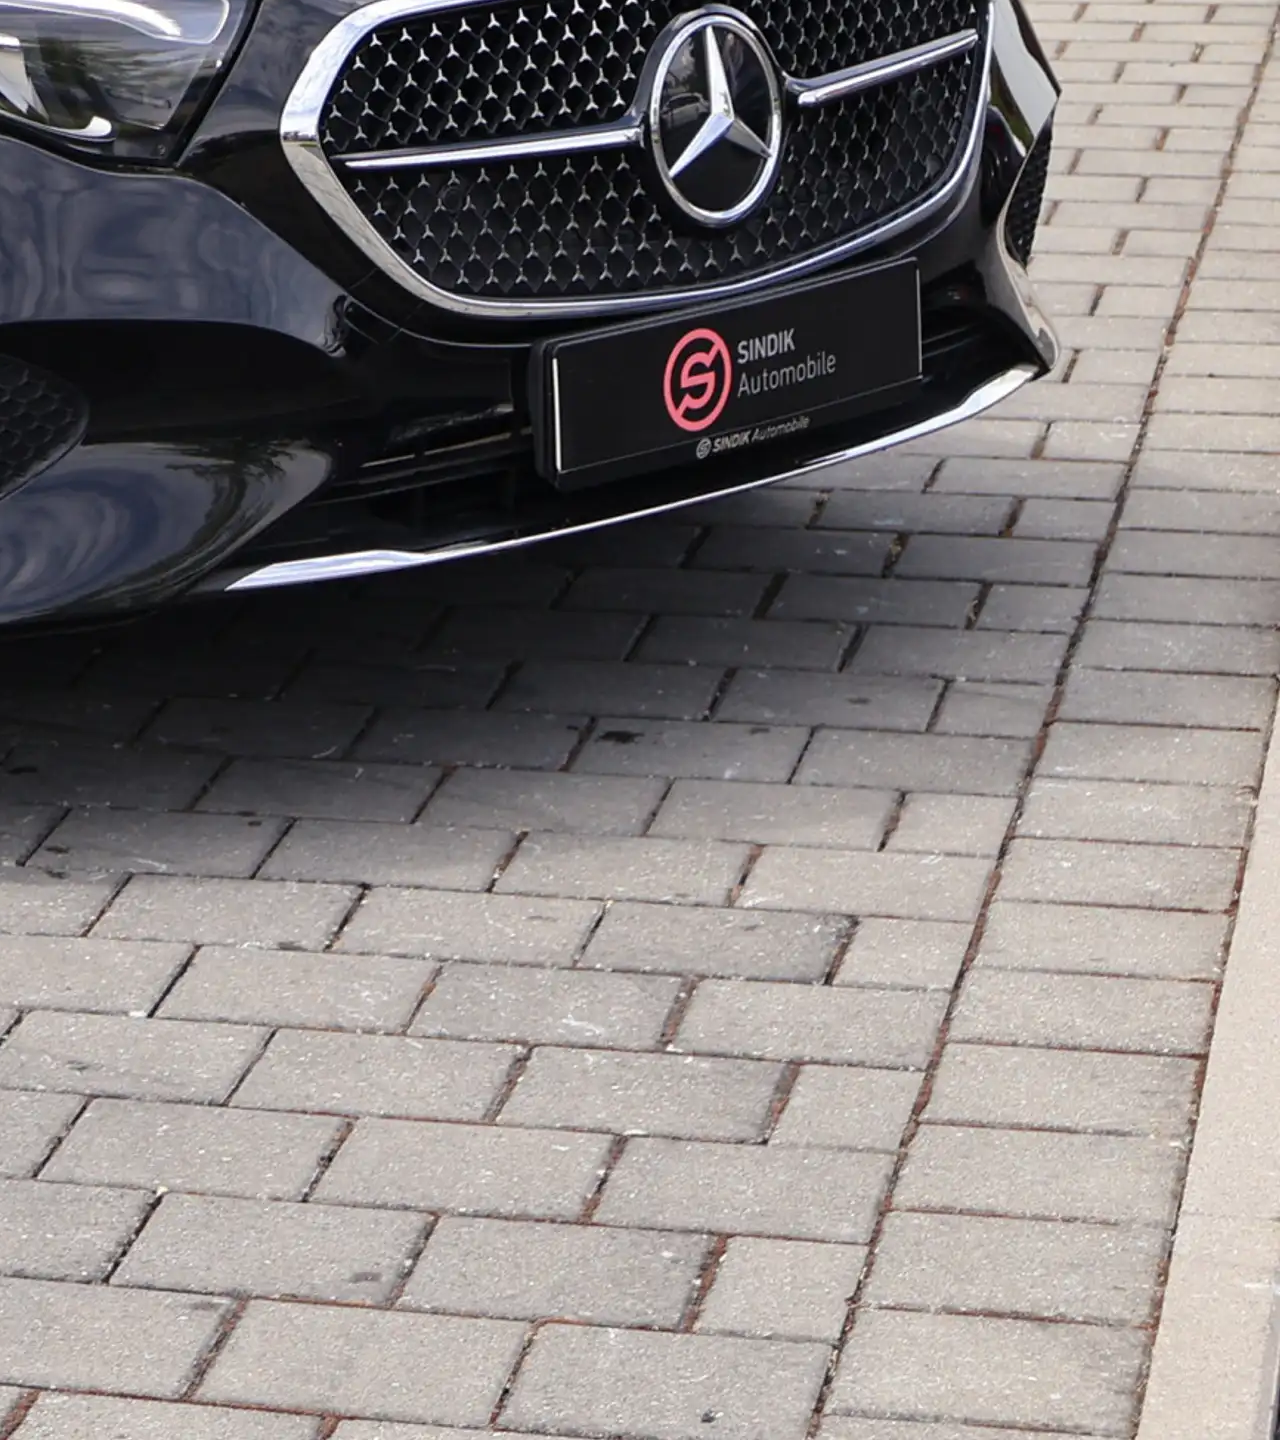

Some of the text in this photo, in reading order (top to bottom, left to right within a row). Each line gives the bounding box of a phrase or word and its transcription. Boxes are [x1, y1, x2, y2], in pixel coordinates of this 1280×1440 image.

[737, 327, 796, 364] SINDIK
[736, 350, 836, 399] Automobile
[711, 415, 811, 453] SINDIK Automobile
